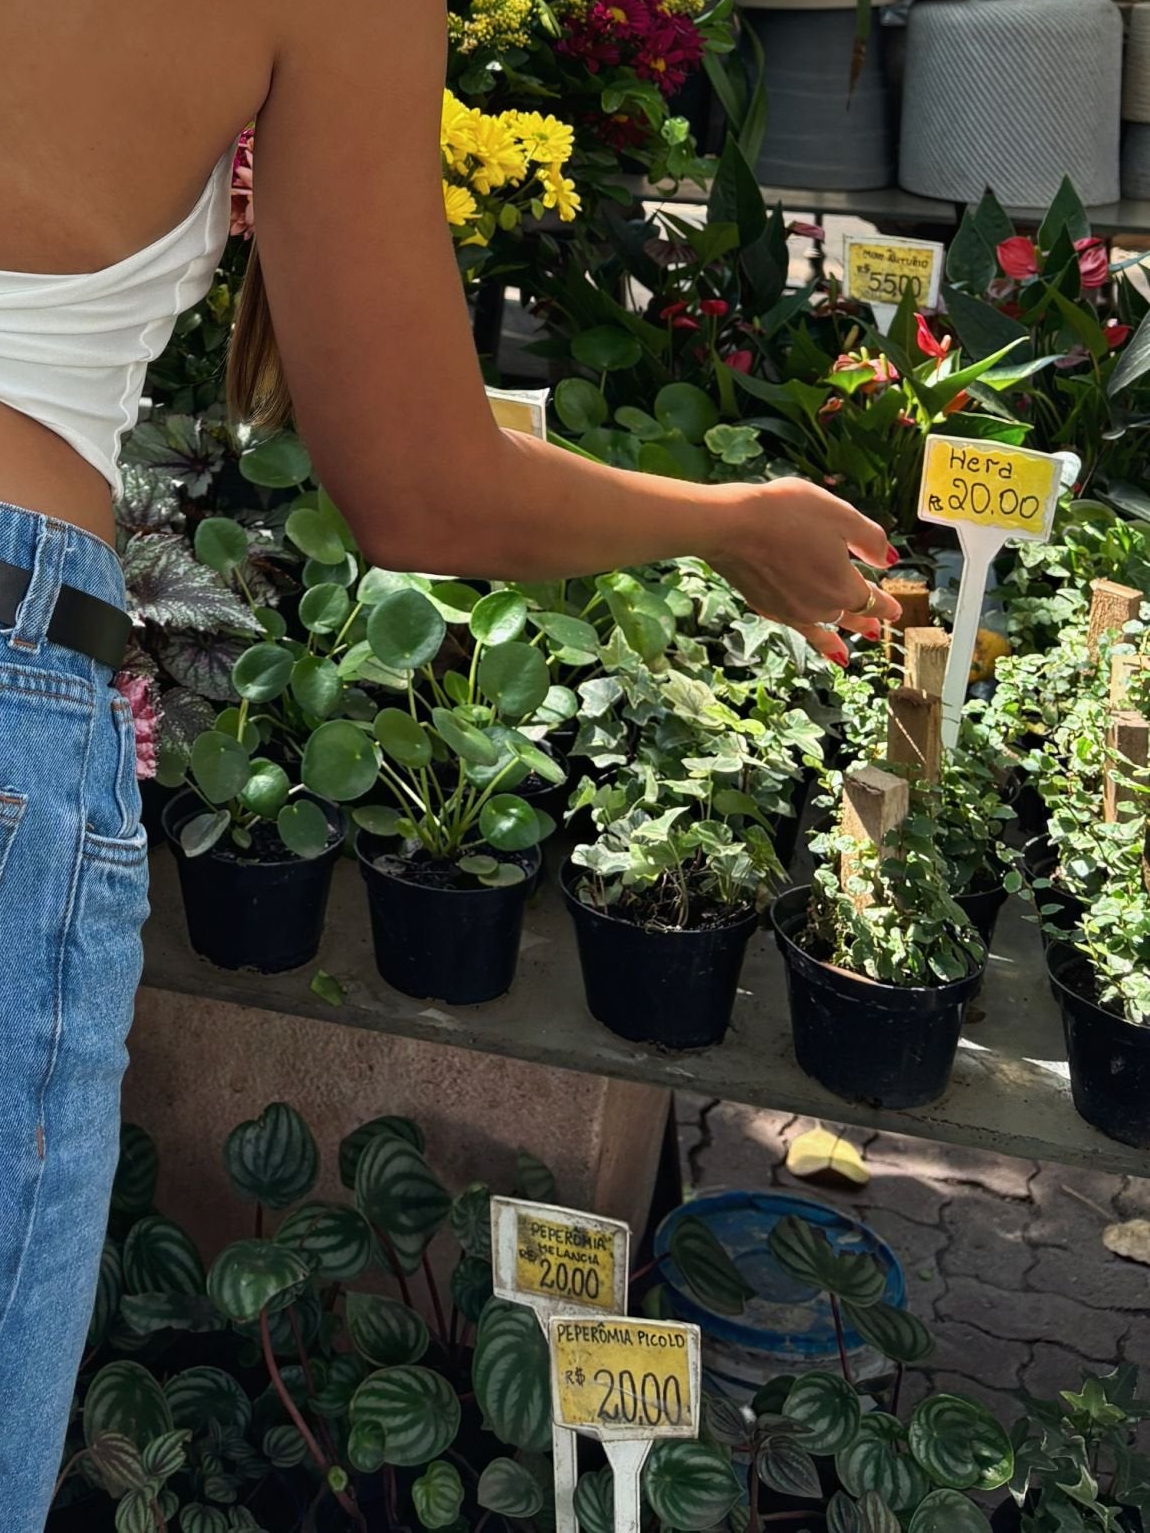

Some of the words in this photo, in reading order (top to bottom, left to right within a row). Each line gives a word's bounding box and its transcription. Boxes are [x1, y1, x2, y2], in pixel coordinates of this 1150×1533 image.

[868, 272, 921, 298] 55,00
[949, 448, 1013, 479] Hera
[538, 1242, 599, 1266] MELANCIA
[540, 1258, 599, 1299] 20,00
[556, 1321, 633, 1346] PEPERÔMIA
[565, 1367, 586, 1387] R$
[593, 1368, 682, 1427] 20,00
